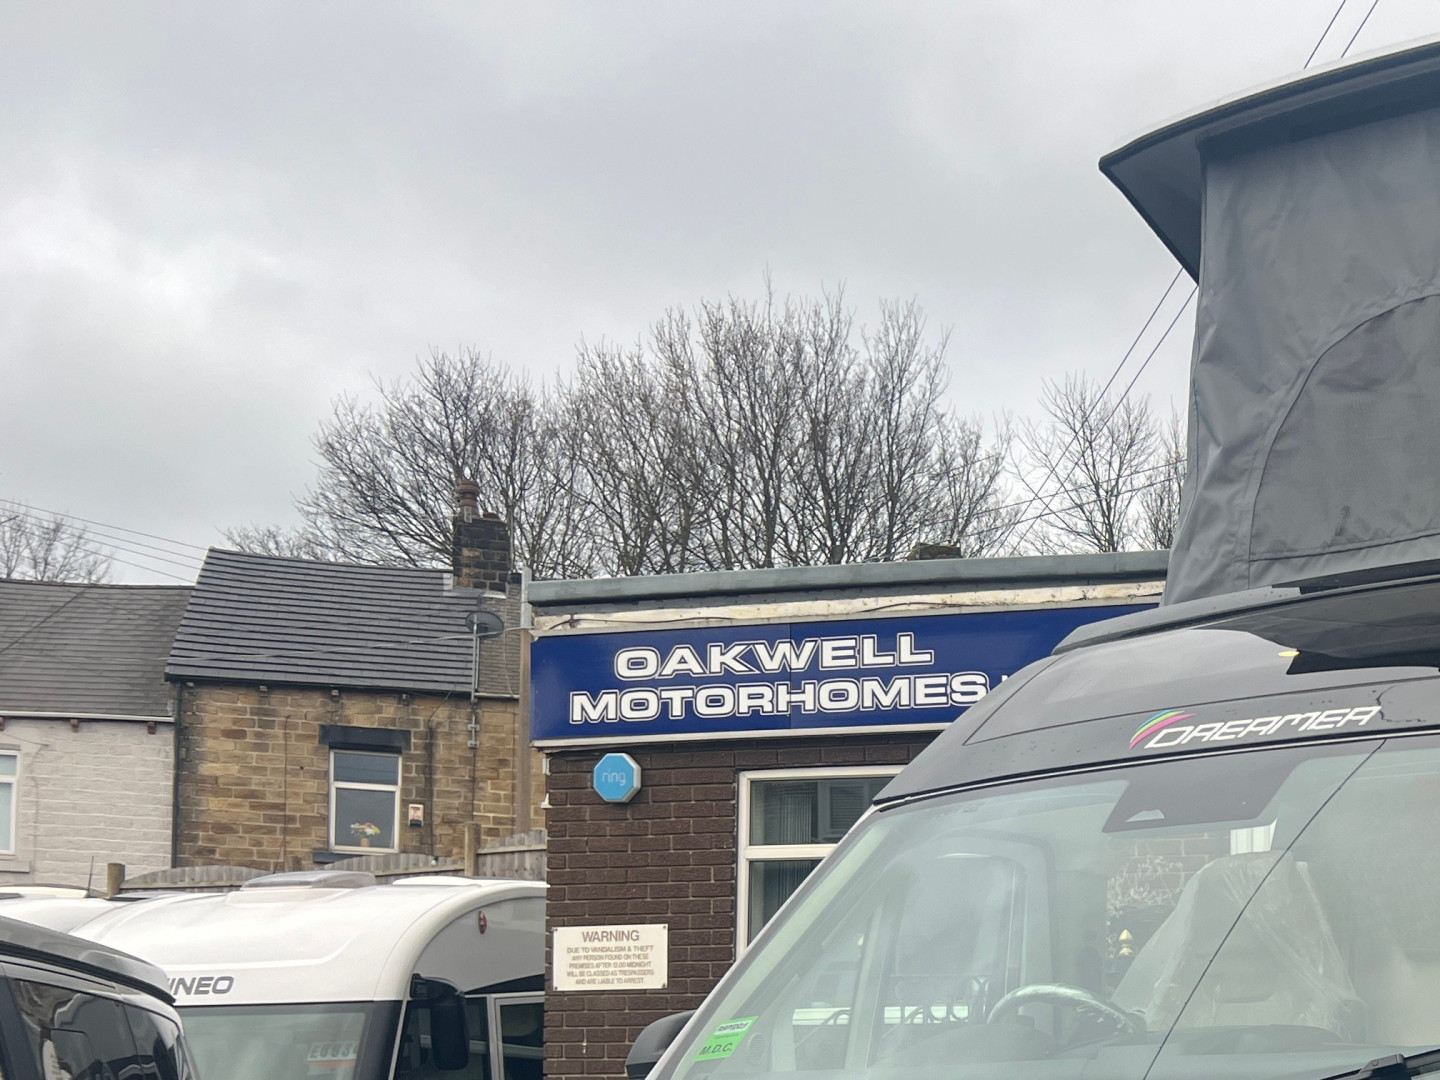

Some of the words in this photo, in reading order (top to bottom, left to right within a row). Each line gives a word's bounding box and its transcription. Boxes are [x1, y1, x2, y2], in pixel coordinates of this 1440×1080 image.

[614, 632, 935, 680] OAKWELL
[569, 671, 991, 725] MOTORHOMES
[1143, 705, 1382, 750] DREAMER
[602, 769, 626, 786] ring
[582, 929, 640, 942] WARNING
[167, 976, 235, 996] INEO
